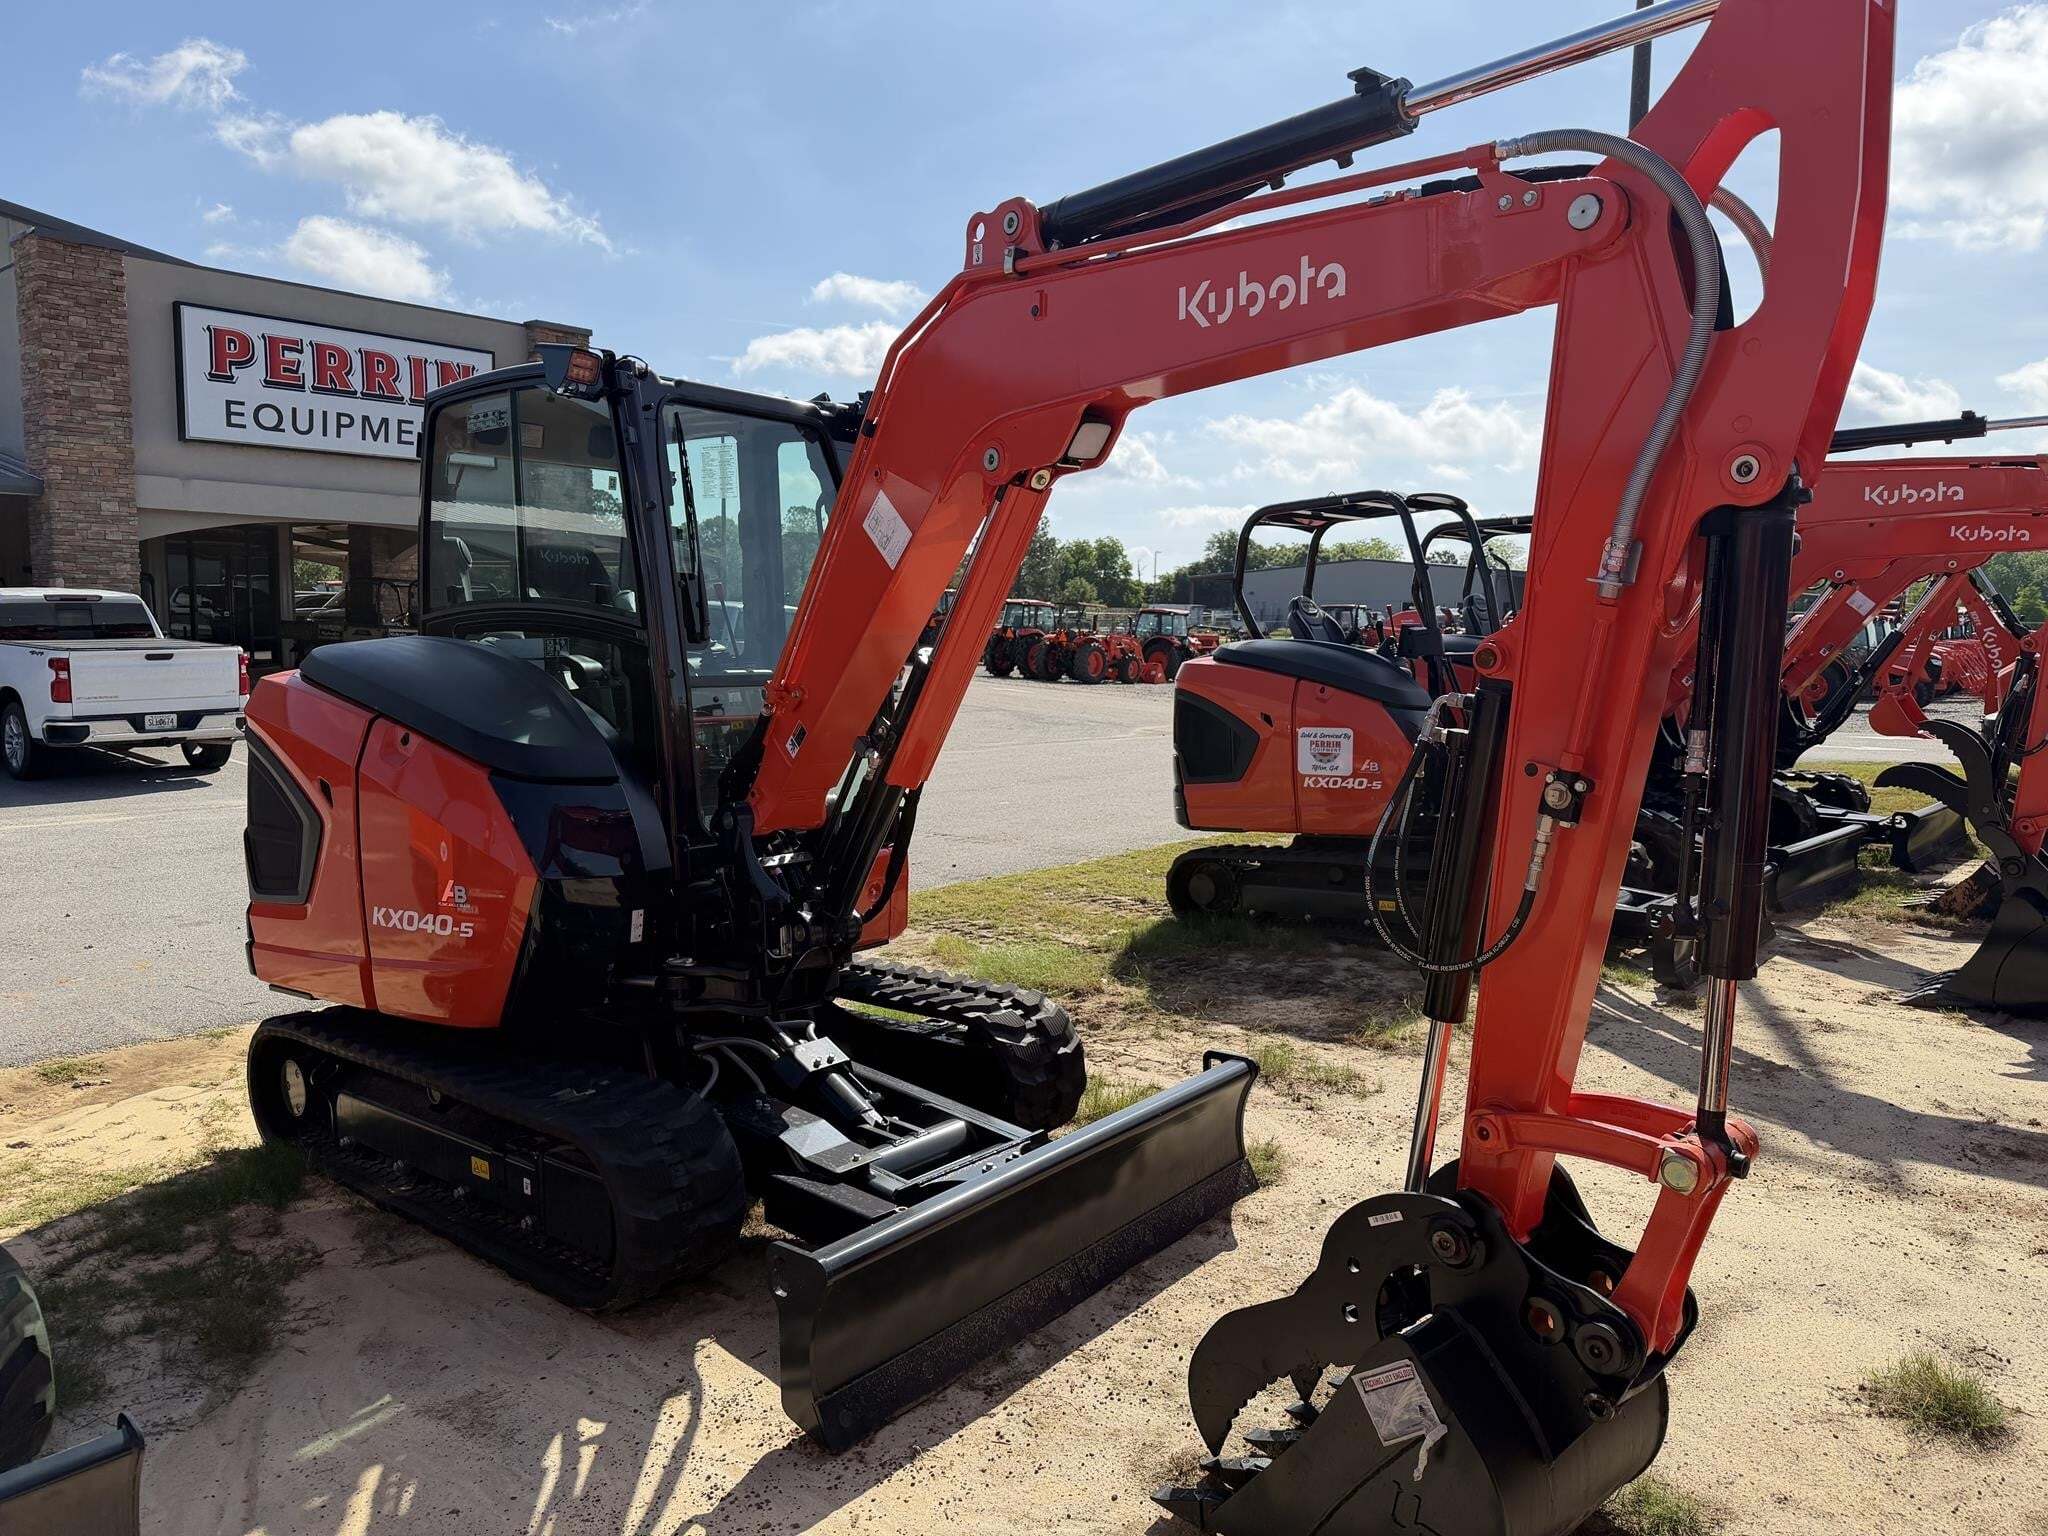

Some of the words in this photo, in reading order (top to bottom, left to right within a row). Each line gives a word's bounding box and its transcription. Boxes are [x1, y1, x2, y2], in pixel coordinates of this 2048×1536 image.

[1179, 255, 1346, 328] Kubota
[224, 399, 415, 446] EQUIPME
[1864, 481, 1964, 506] Kubota
[1950, 525, 2030, 541] Kubota
[540, 550, 590, 565] Kubota
[1982, 626, 2003, 674] Kubo
[1309, 740, 1341, 748] PERRIN
[1342, 733, 1351, 741] By
[1303, 776, 1383, 790] KX040-5
[372, 906, 474, 938] KX040-5
[1477, 950, 1494, 963] MSHA
[1417, 960, 1439, 971] FLAME
[1440, 960, 1474, 972] RESISTANT
